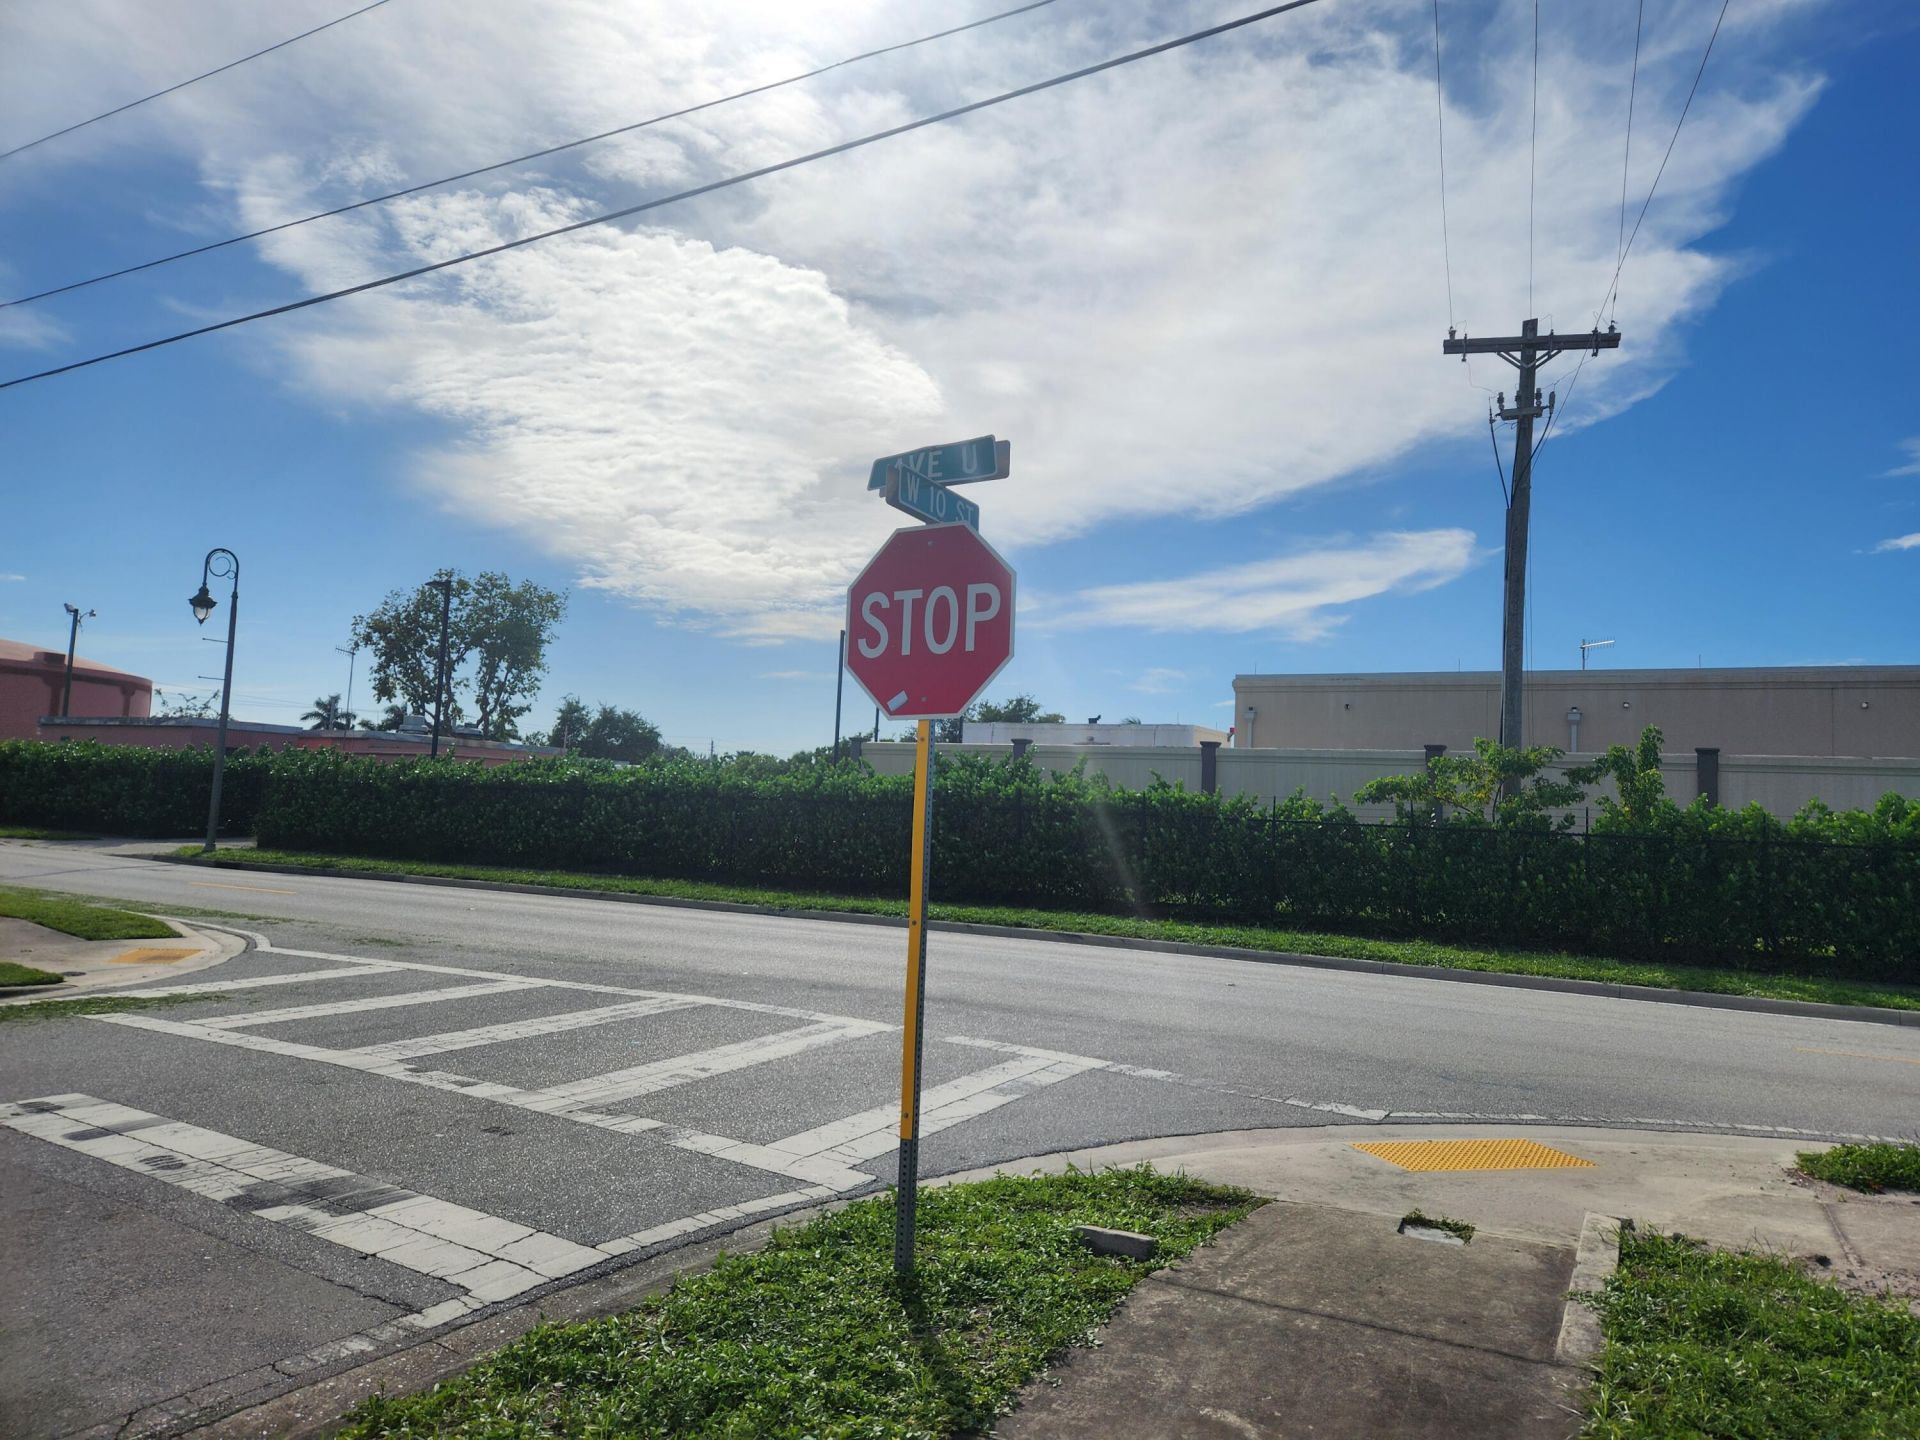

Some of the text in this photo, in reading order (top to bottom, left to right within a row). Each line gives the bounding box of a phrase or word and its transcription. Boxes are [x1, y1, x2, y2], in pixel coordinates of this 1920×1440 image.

[962, 444, 978, 474] U
[906, 471, 975, 526] W 10 ST
[857, 582, 1001, 659] STOP
